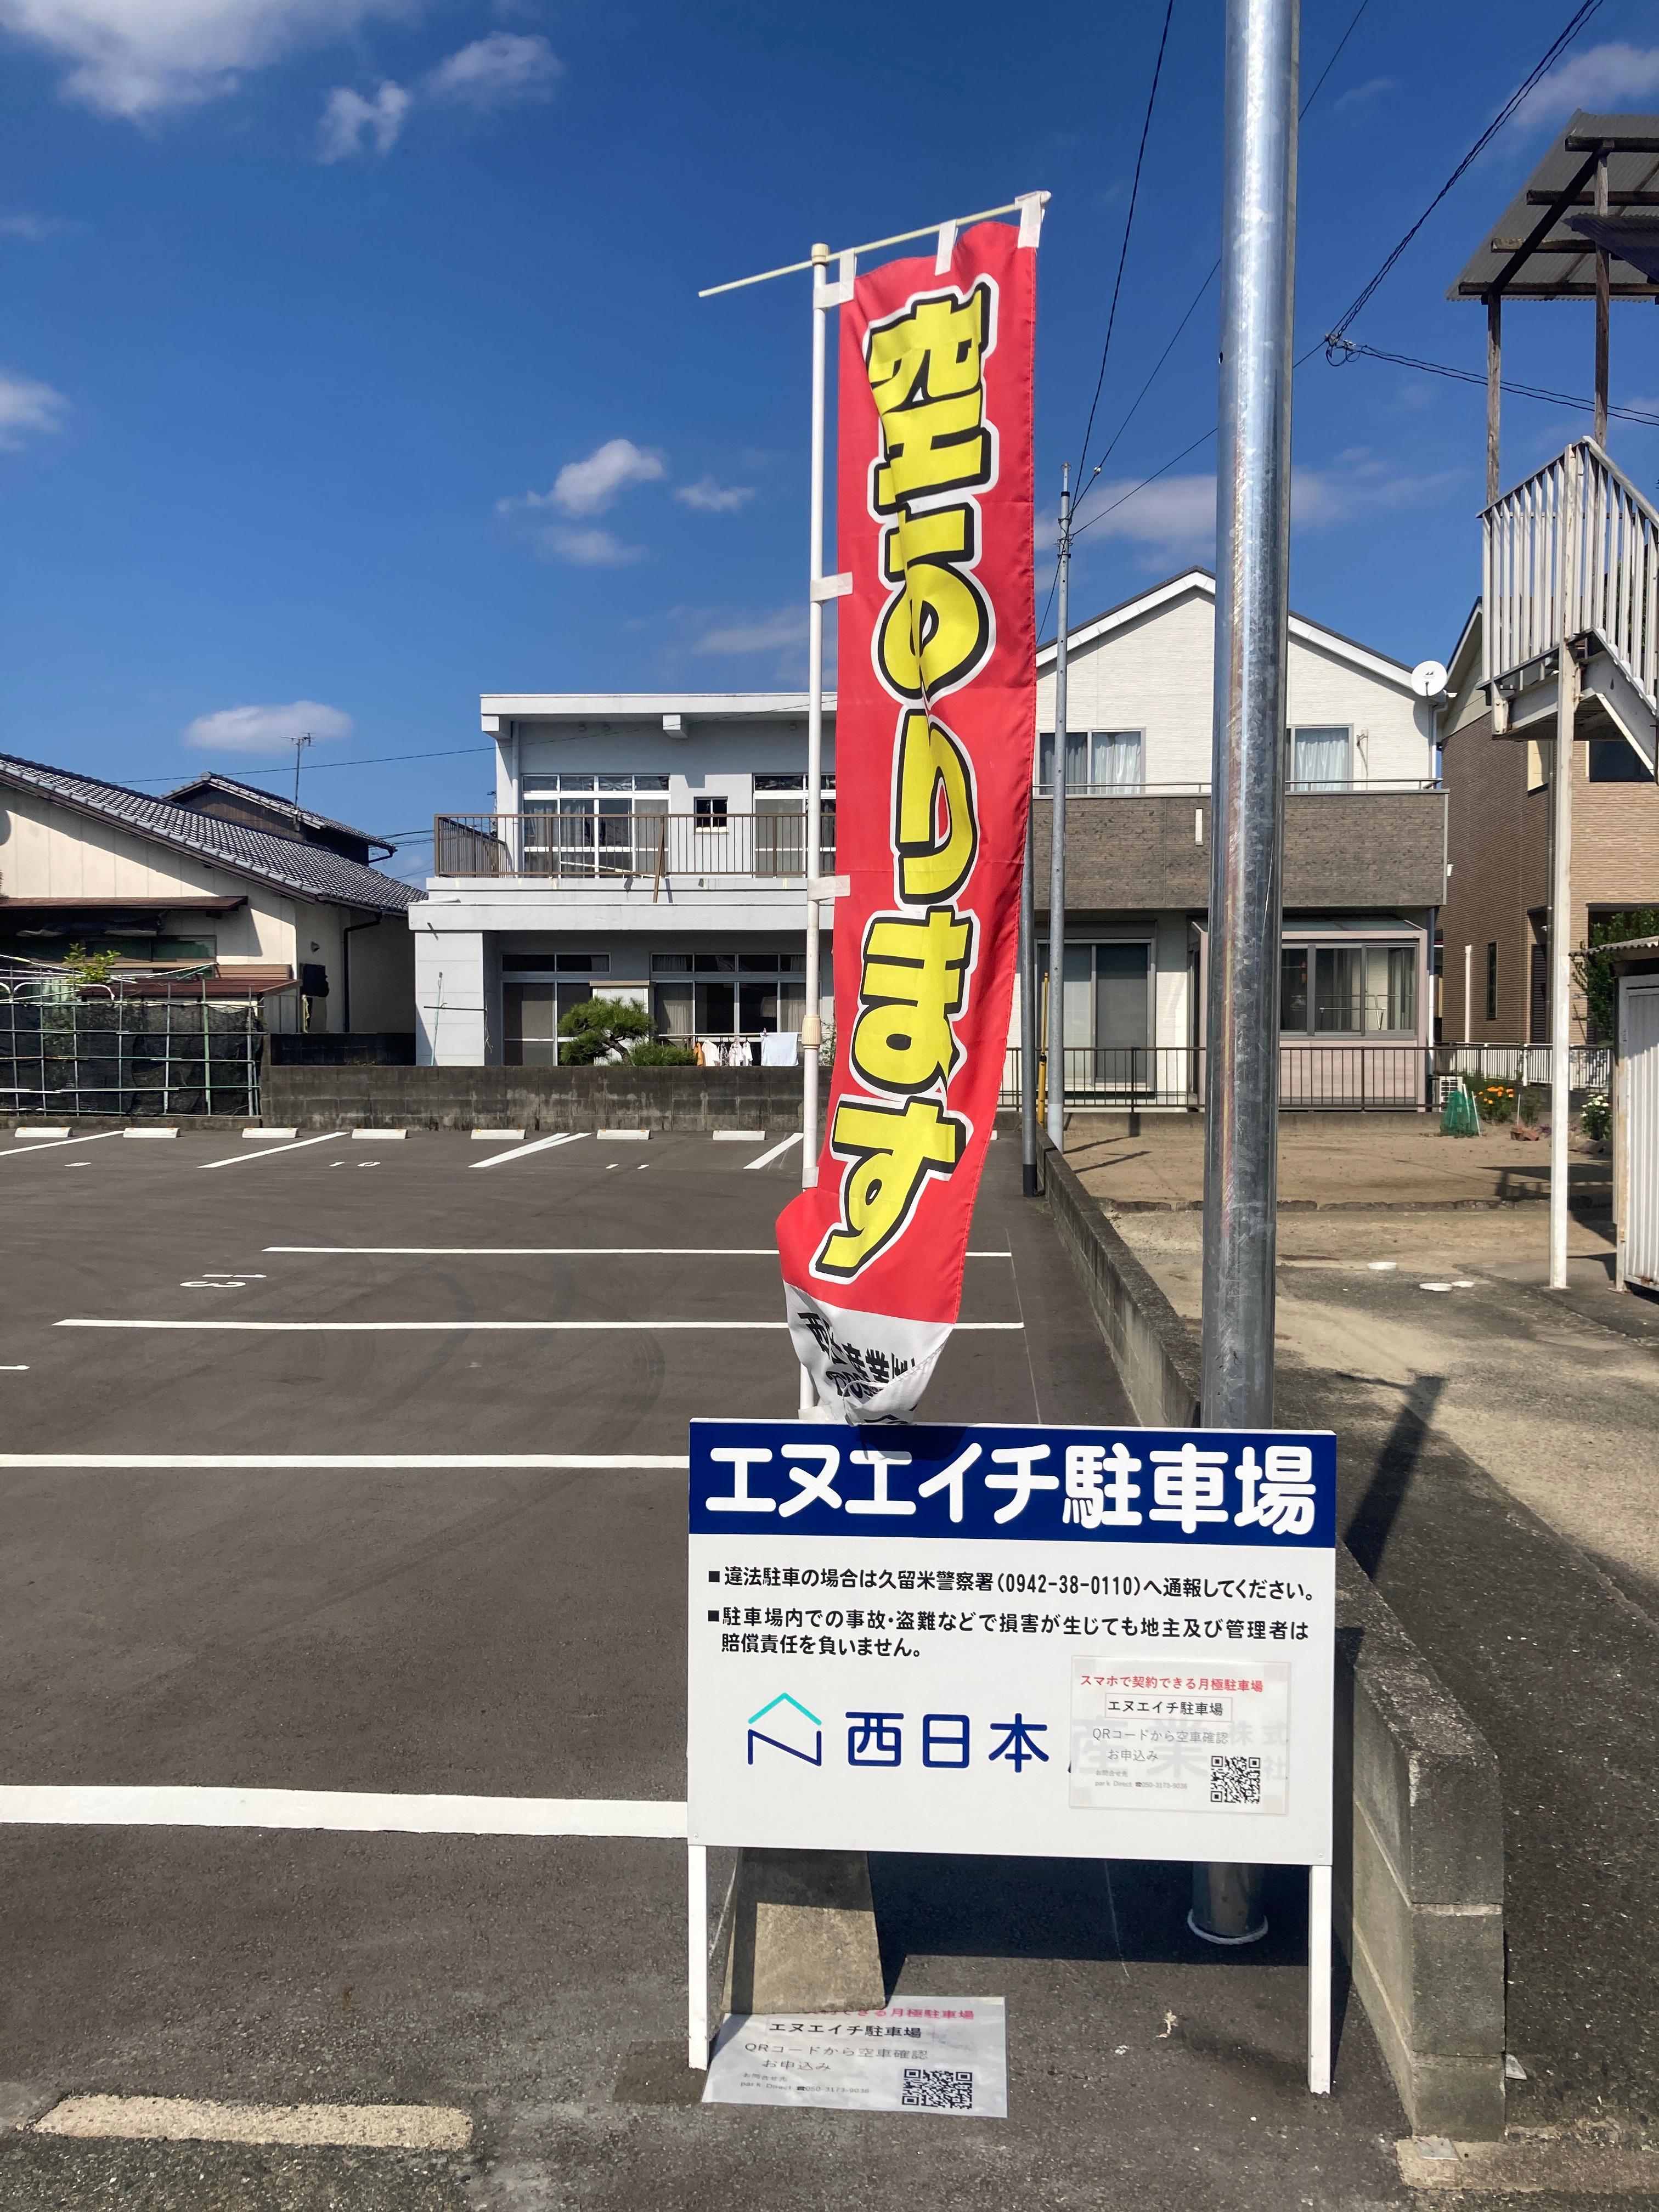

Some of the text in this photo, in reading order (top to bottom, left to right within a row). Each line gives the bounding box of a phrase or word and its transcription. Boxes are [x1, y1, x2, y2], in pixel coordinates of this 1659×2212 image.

[811, 275, 1000, 1283] 空あります
[705, 1443, 1317, 1535] エヌエイチ駐車場
[721, 1633, 920, 1657] 賠償責任を負いません。
[1080, 1675, 1263, 1692] スマホで契約できる月極駐車場
[1107, 1700, 1223, 1717] エヌエイチ駐車場
[1092, 1728, 1229, 1745] QRコードから空車確認
[1107, 1748, 1159, 1762] お申込み
[769, 2023, 922, 2039] エヌエイチ駐車場
[744, 2042, 928, 2061] QRコードから空車確認
[761, 2059, 831, 2072] お申込み
